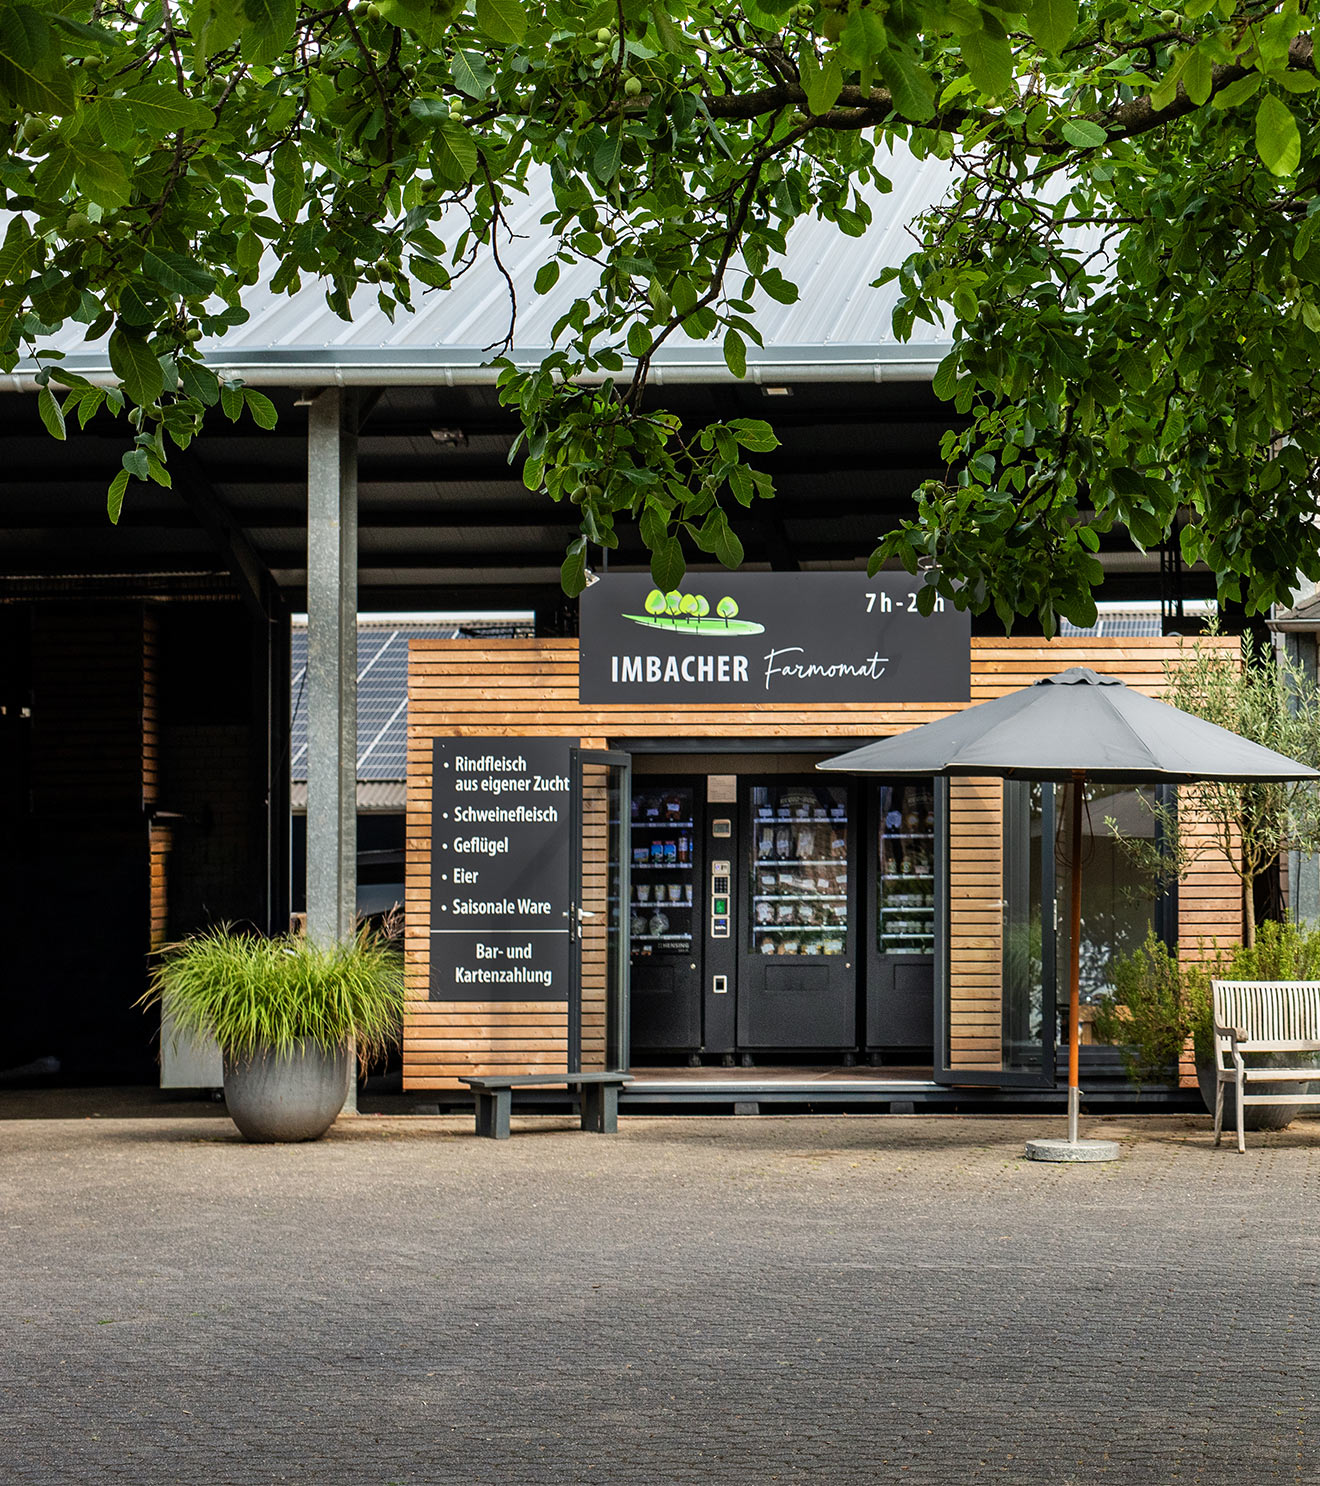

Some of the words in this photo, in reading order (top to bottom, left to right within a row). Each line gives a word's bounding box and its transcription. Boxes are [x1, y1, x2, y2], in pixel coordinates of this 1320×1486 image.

[612, 656, 748, 682] IMBACHER
[764, 648, 888, 689] Farmomat
[456, 756, 526, 771] Rindfleisch
[456, 780, 478, 791] aus
[481, 776, 531, 795] eigener
[534, 776, 569, 791] Zucht
[455, 806, 557, 821] Schweinefleisch
[454, 837, 508, 856] Geflügel
[454, 868, 478, 883] Eier
[453, 899, 514, 914] Saisonale
[518, 899, 551, 914] Ware
[477, 944, 503, 958] Bar-
[507, 943, 531, 958] und
[456, 967, 551, 986] Kartenzahlung
